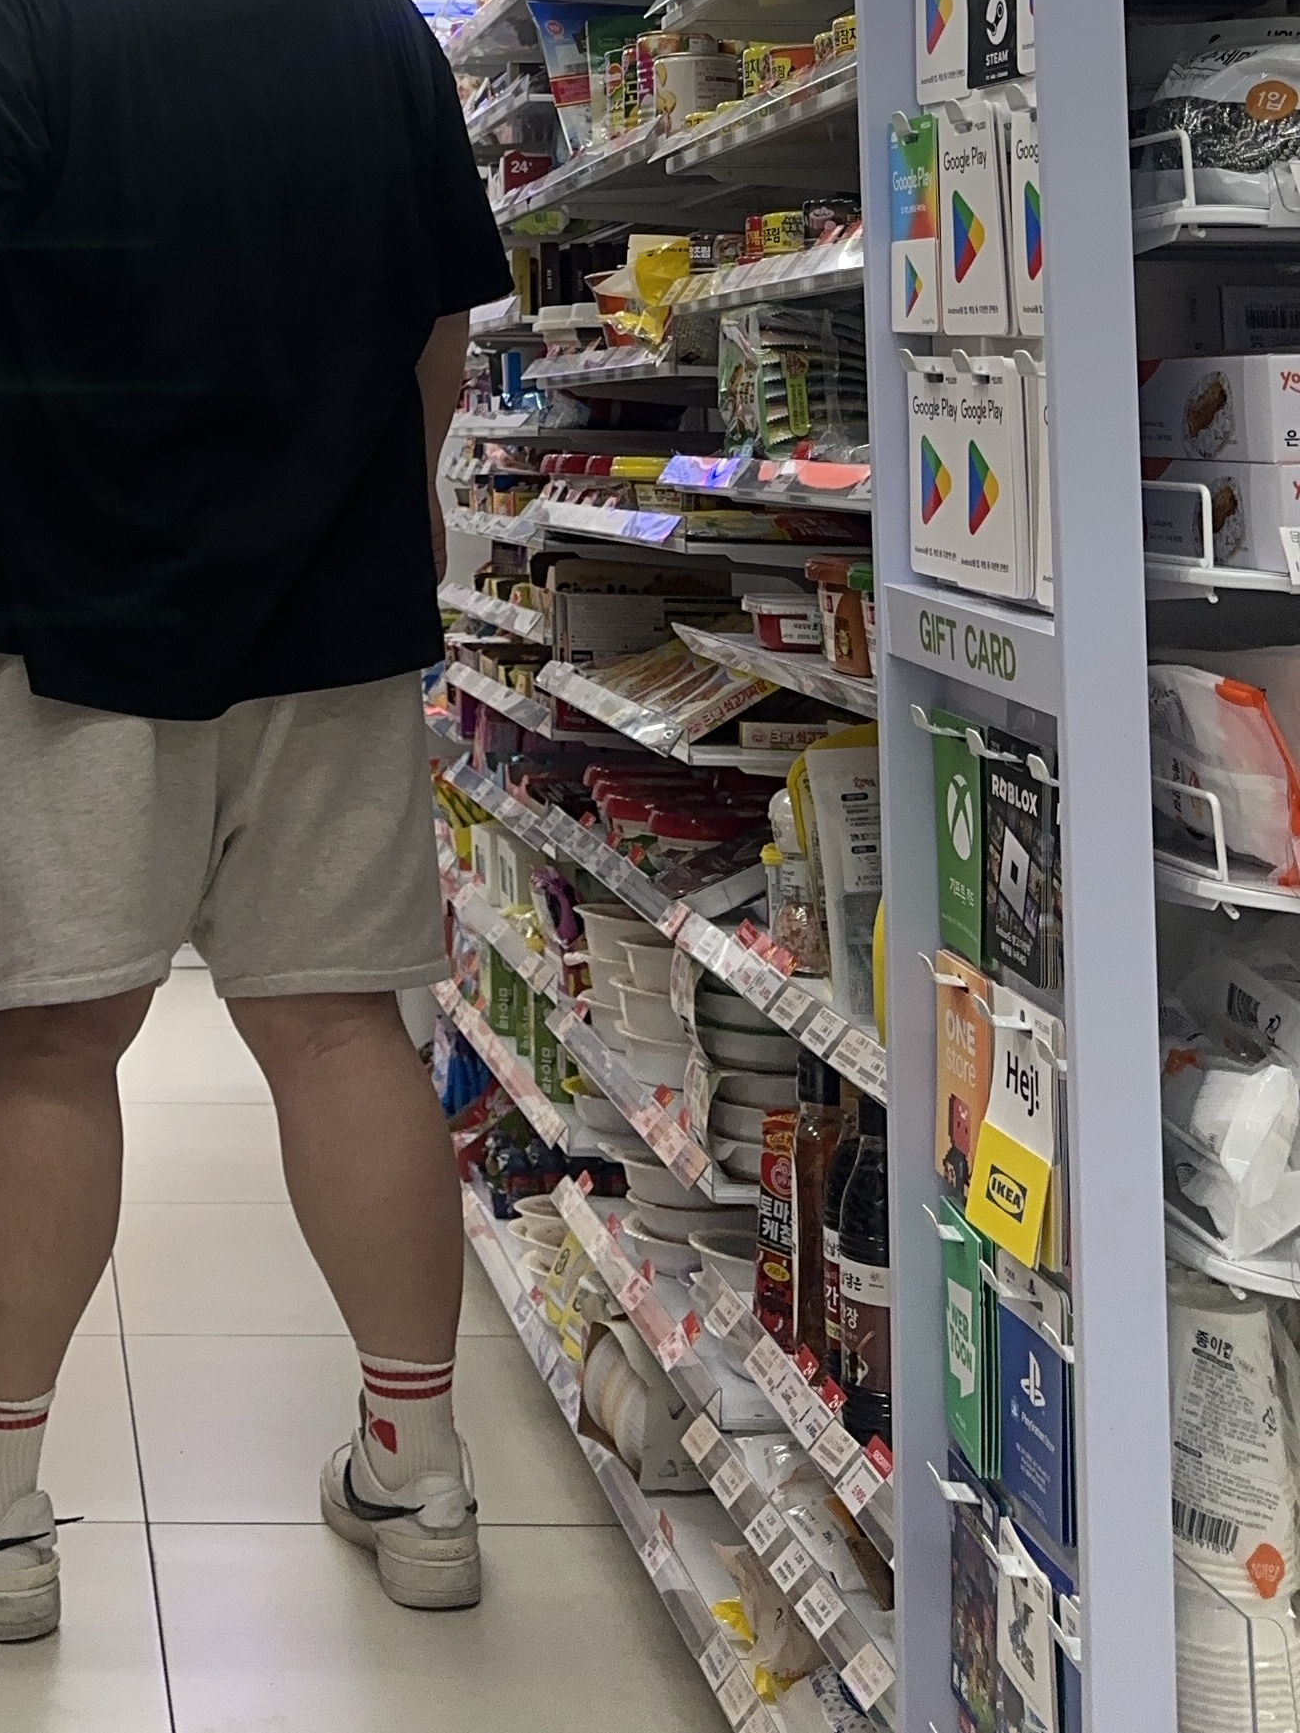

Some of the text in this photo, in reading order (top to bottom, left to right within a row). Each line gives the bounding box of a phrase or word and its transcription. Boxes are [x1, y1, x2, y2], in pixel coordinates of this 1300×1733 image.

[985, 49, 1009, 67] STEAM
[943, 145, 988, 174] Google Play
[1015, 139, 1040, 163] Goog
[892, 170, 918, 196] Google
[912, 395, 958, 423] Google Play
[960, 398, 1004, 425] Google Play
[919, 609, 1017, 682] GIFT CARD
[991, 773, 1038, 818] ROBLOX
[945, 1007, 977, 1057] ONE
[945, 1053, 977, 1090] store
[1005, 1051, 1041, 1117] Hej!
[760, 1195, 792, 1224] 토마
[990, 1172, 1026, 1212] IKEA
[950, 1301, 970, 1344] WEB
[947, 1320, 975, 1373] TOON
